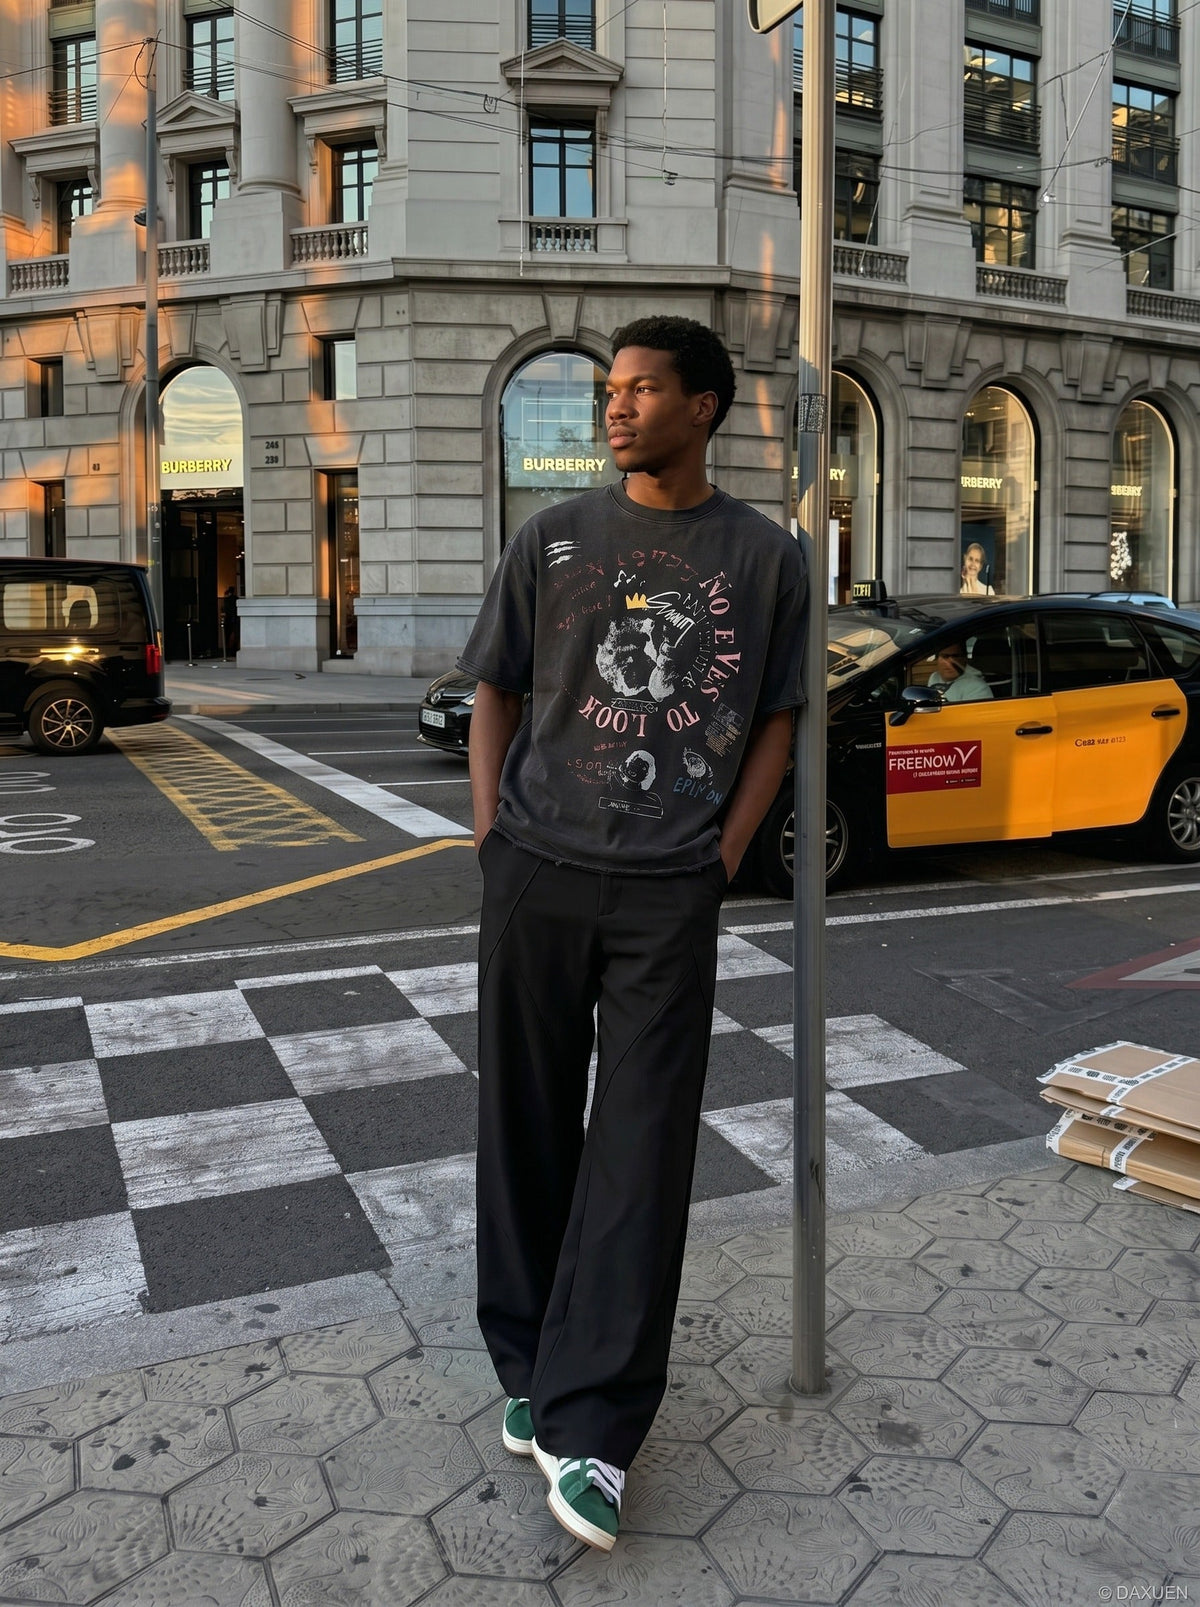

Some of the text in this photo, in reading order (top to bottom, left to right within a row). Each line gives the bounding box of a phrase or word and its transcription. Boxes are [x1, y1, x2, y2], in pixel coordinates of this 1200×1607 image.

[161, 459, 232, 474] BURBERRY
[523, 458, 606, 472] BURBERRY
[578, 695, 647, 737] LOOK
[666, 701, 700, 732] TO
[889, 754, 957, 771] FREENOW
